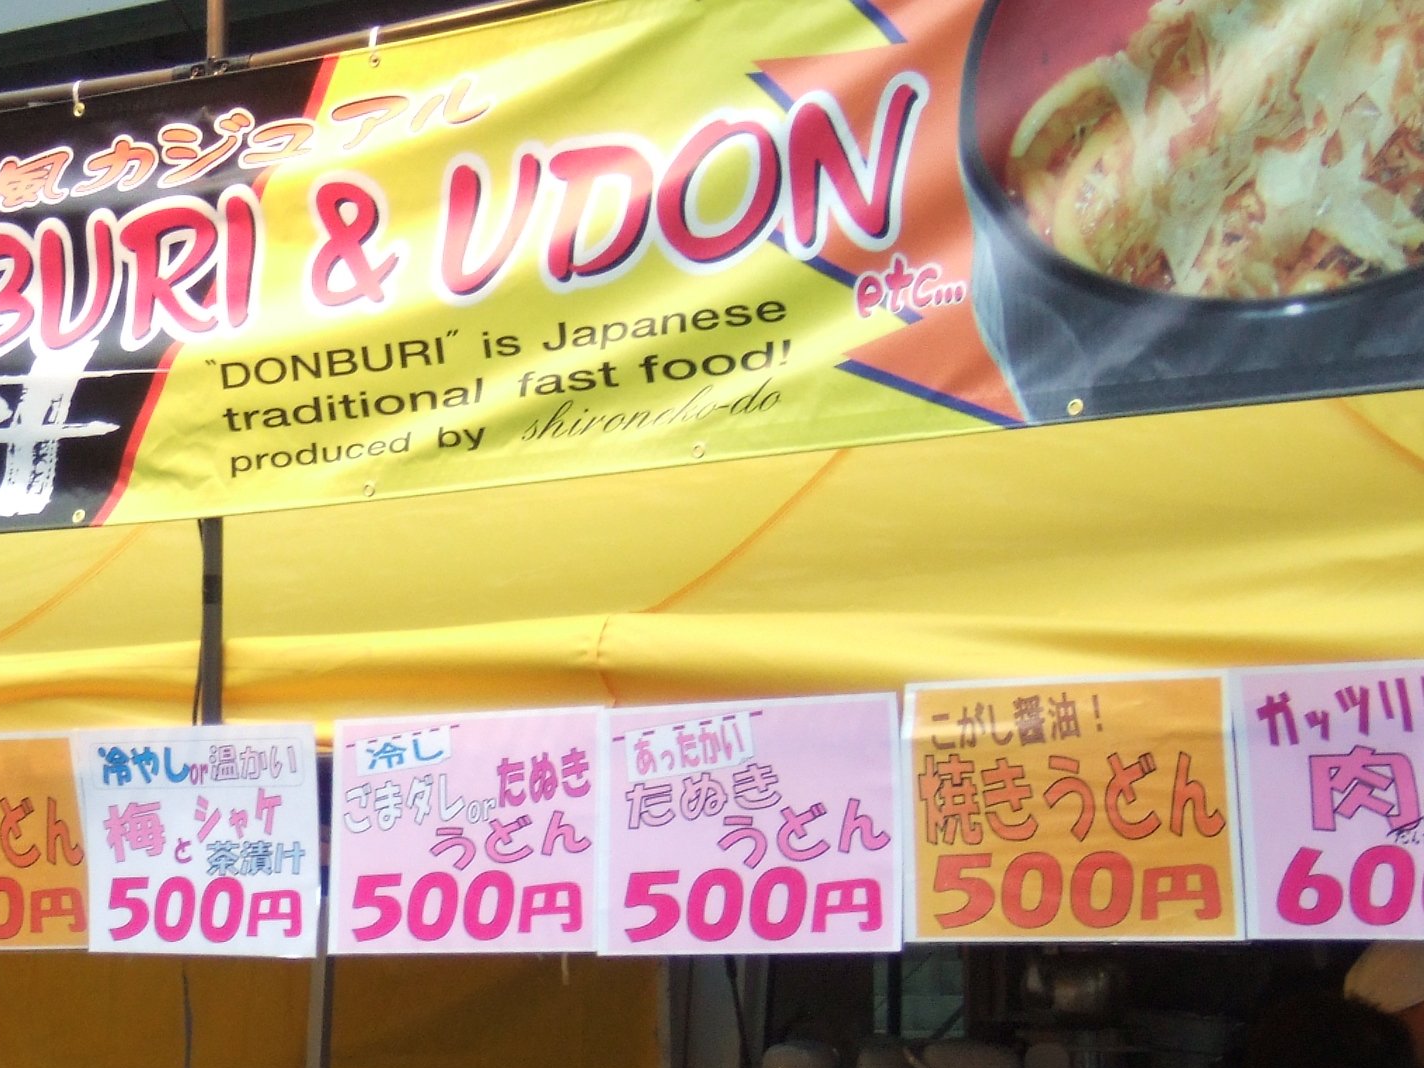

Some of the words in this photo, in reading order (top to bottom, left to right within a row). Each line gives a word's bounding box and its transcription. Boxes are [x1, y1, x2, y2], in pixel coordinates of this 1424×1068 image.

[309, 171, 402, 310] &
[440, 70, 929, 305] UDON
[482, 331, 522, 359] is
[542, 300, 788, 350] Japanese
[222, 377, 484, 432] traditional
[518, 361, 619, 398] fast
[638, 338, 792, 384] food!
[230, 431, 412, 478] produced
[437, 426, 486, 451] by
[521, 377, 782, 442] shironeko-do
[1258, 675, 1424, 747] ガッツリ
[634, 722, 746, 776] あったかい
[625, 762, 782, 830] たぬき
[918, 750, 1226, 846] 焼きうどん
[429, 810, 591, 870] うどん
[717, 798, 890, 870] うどん
[107, 876, 303, 942] 500円
[351, 869, 583, 942] 500円
[623, 866, 884, 943] 500円
[932, 850, 1223, 930] 500円
[1276, 845, 1424, 927] 60
